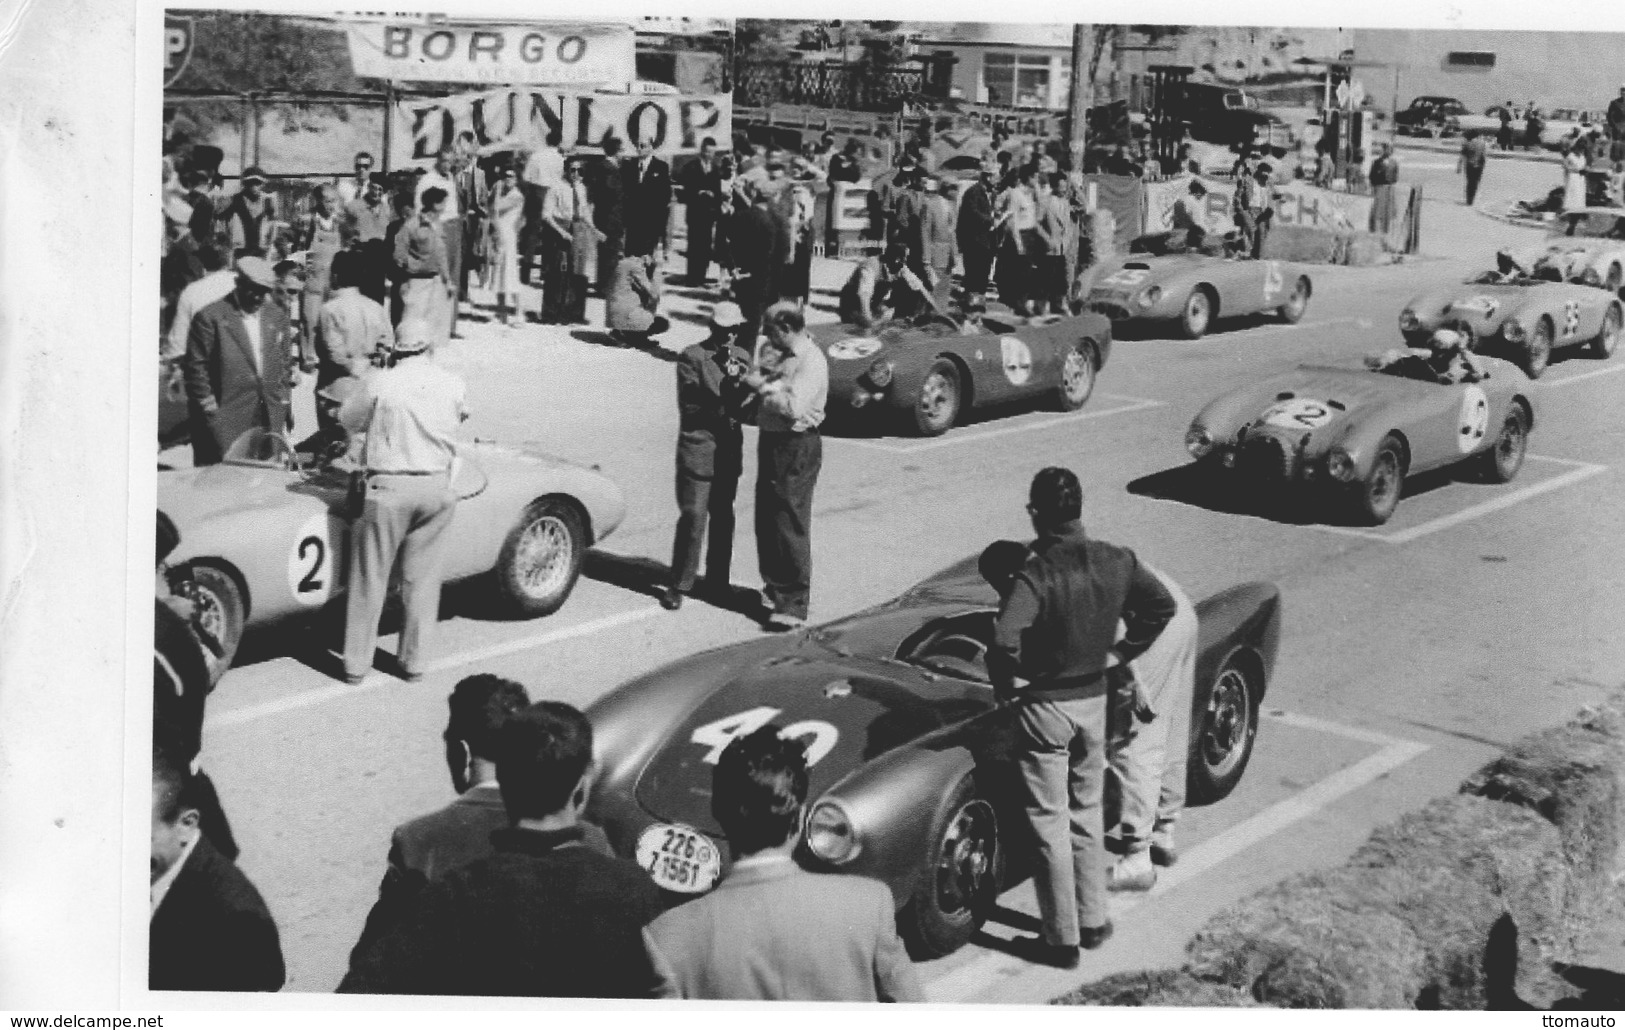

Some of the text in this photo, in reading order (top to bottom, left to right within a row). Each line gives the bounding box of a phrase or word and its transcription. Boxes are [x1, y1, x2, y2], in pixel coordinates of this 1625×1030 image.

[384, 25, 588, 64] BORGO
[411, 92, 720, 160] DUNLOP
[298, 535, 325, 593] 2
